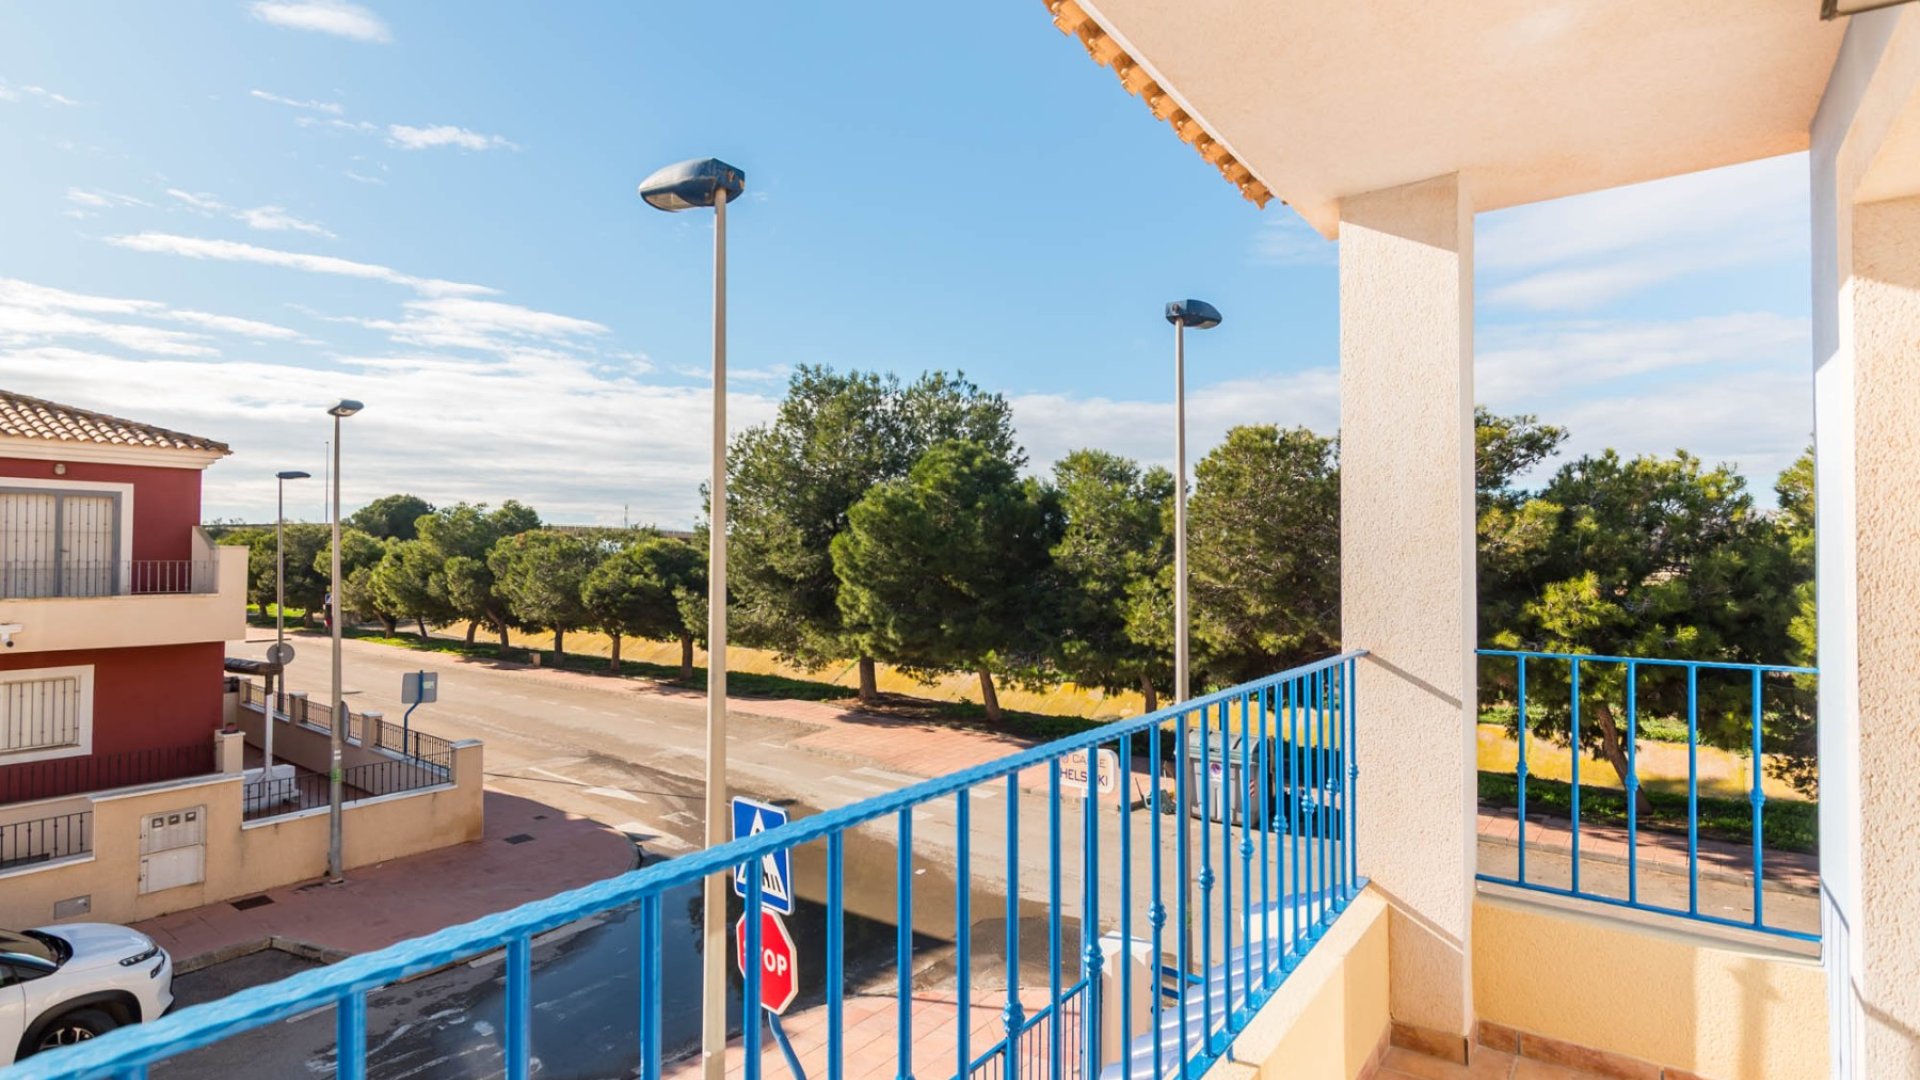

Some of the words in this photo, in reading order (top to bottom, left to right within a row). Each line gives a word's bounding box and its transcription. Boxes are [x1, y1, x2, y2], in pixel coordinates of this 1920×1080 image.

[1072, 754, 1106, 768] CAE
[1060, 768, 1108, 787] HELSKI
[743, 939, 788, 976] OP
